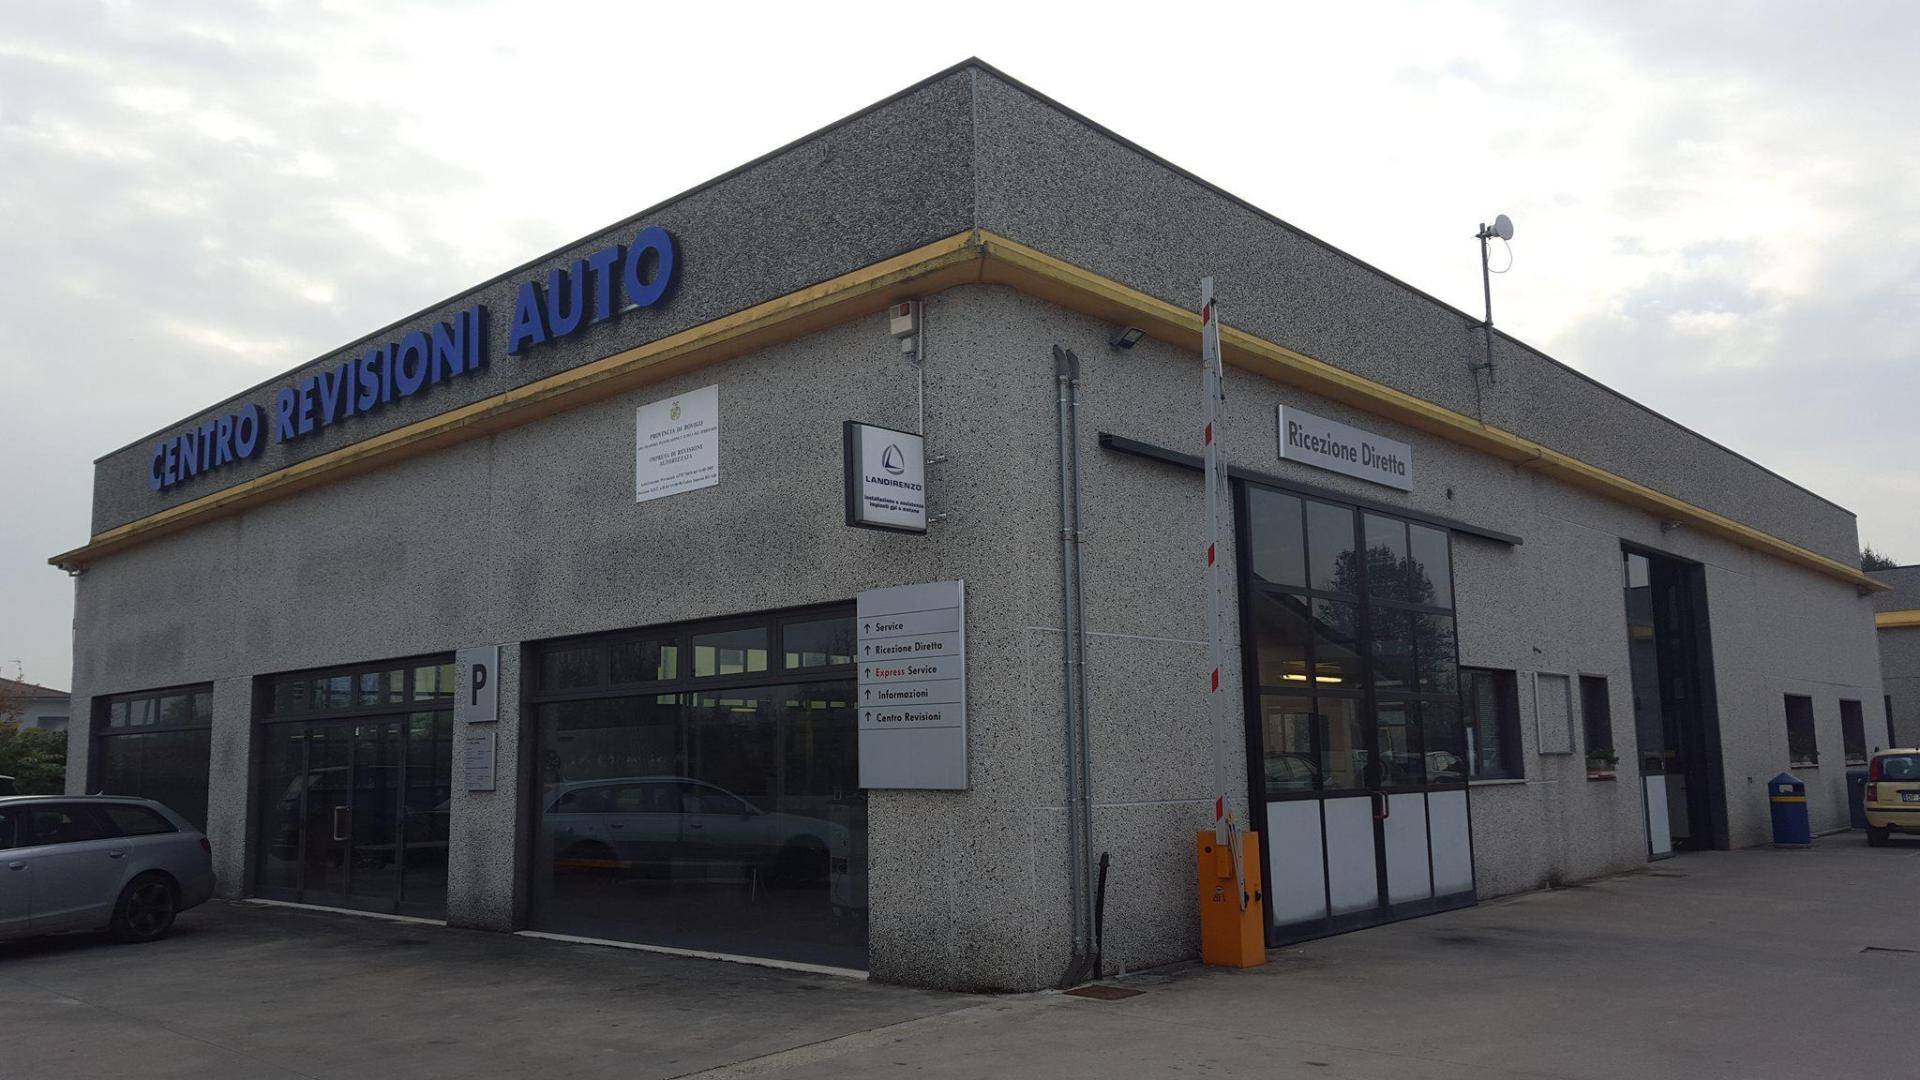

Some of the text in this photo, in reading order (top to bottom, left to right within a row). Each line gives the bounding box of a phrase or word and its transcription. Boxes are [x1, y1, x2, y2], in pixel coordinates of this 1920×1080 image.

[149, 226, 675, 491] CENTRO REVISIONI AUTO
[1288, 420, 1405, 476] Ricezione Diretta
[875, 622, 904, 633] Service
[875, 641, 943, 655] Ricezione Diretta
[875, 665, 937, 679] Express Service
[472, 663, 487, 706] P
[878, 688, 929, 699] Informazioni
[876, 711, 941, 723] Centro Revisioni
